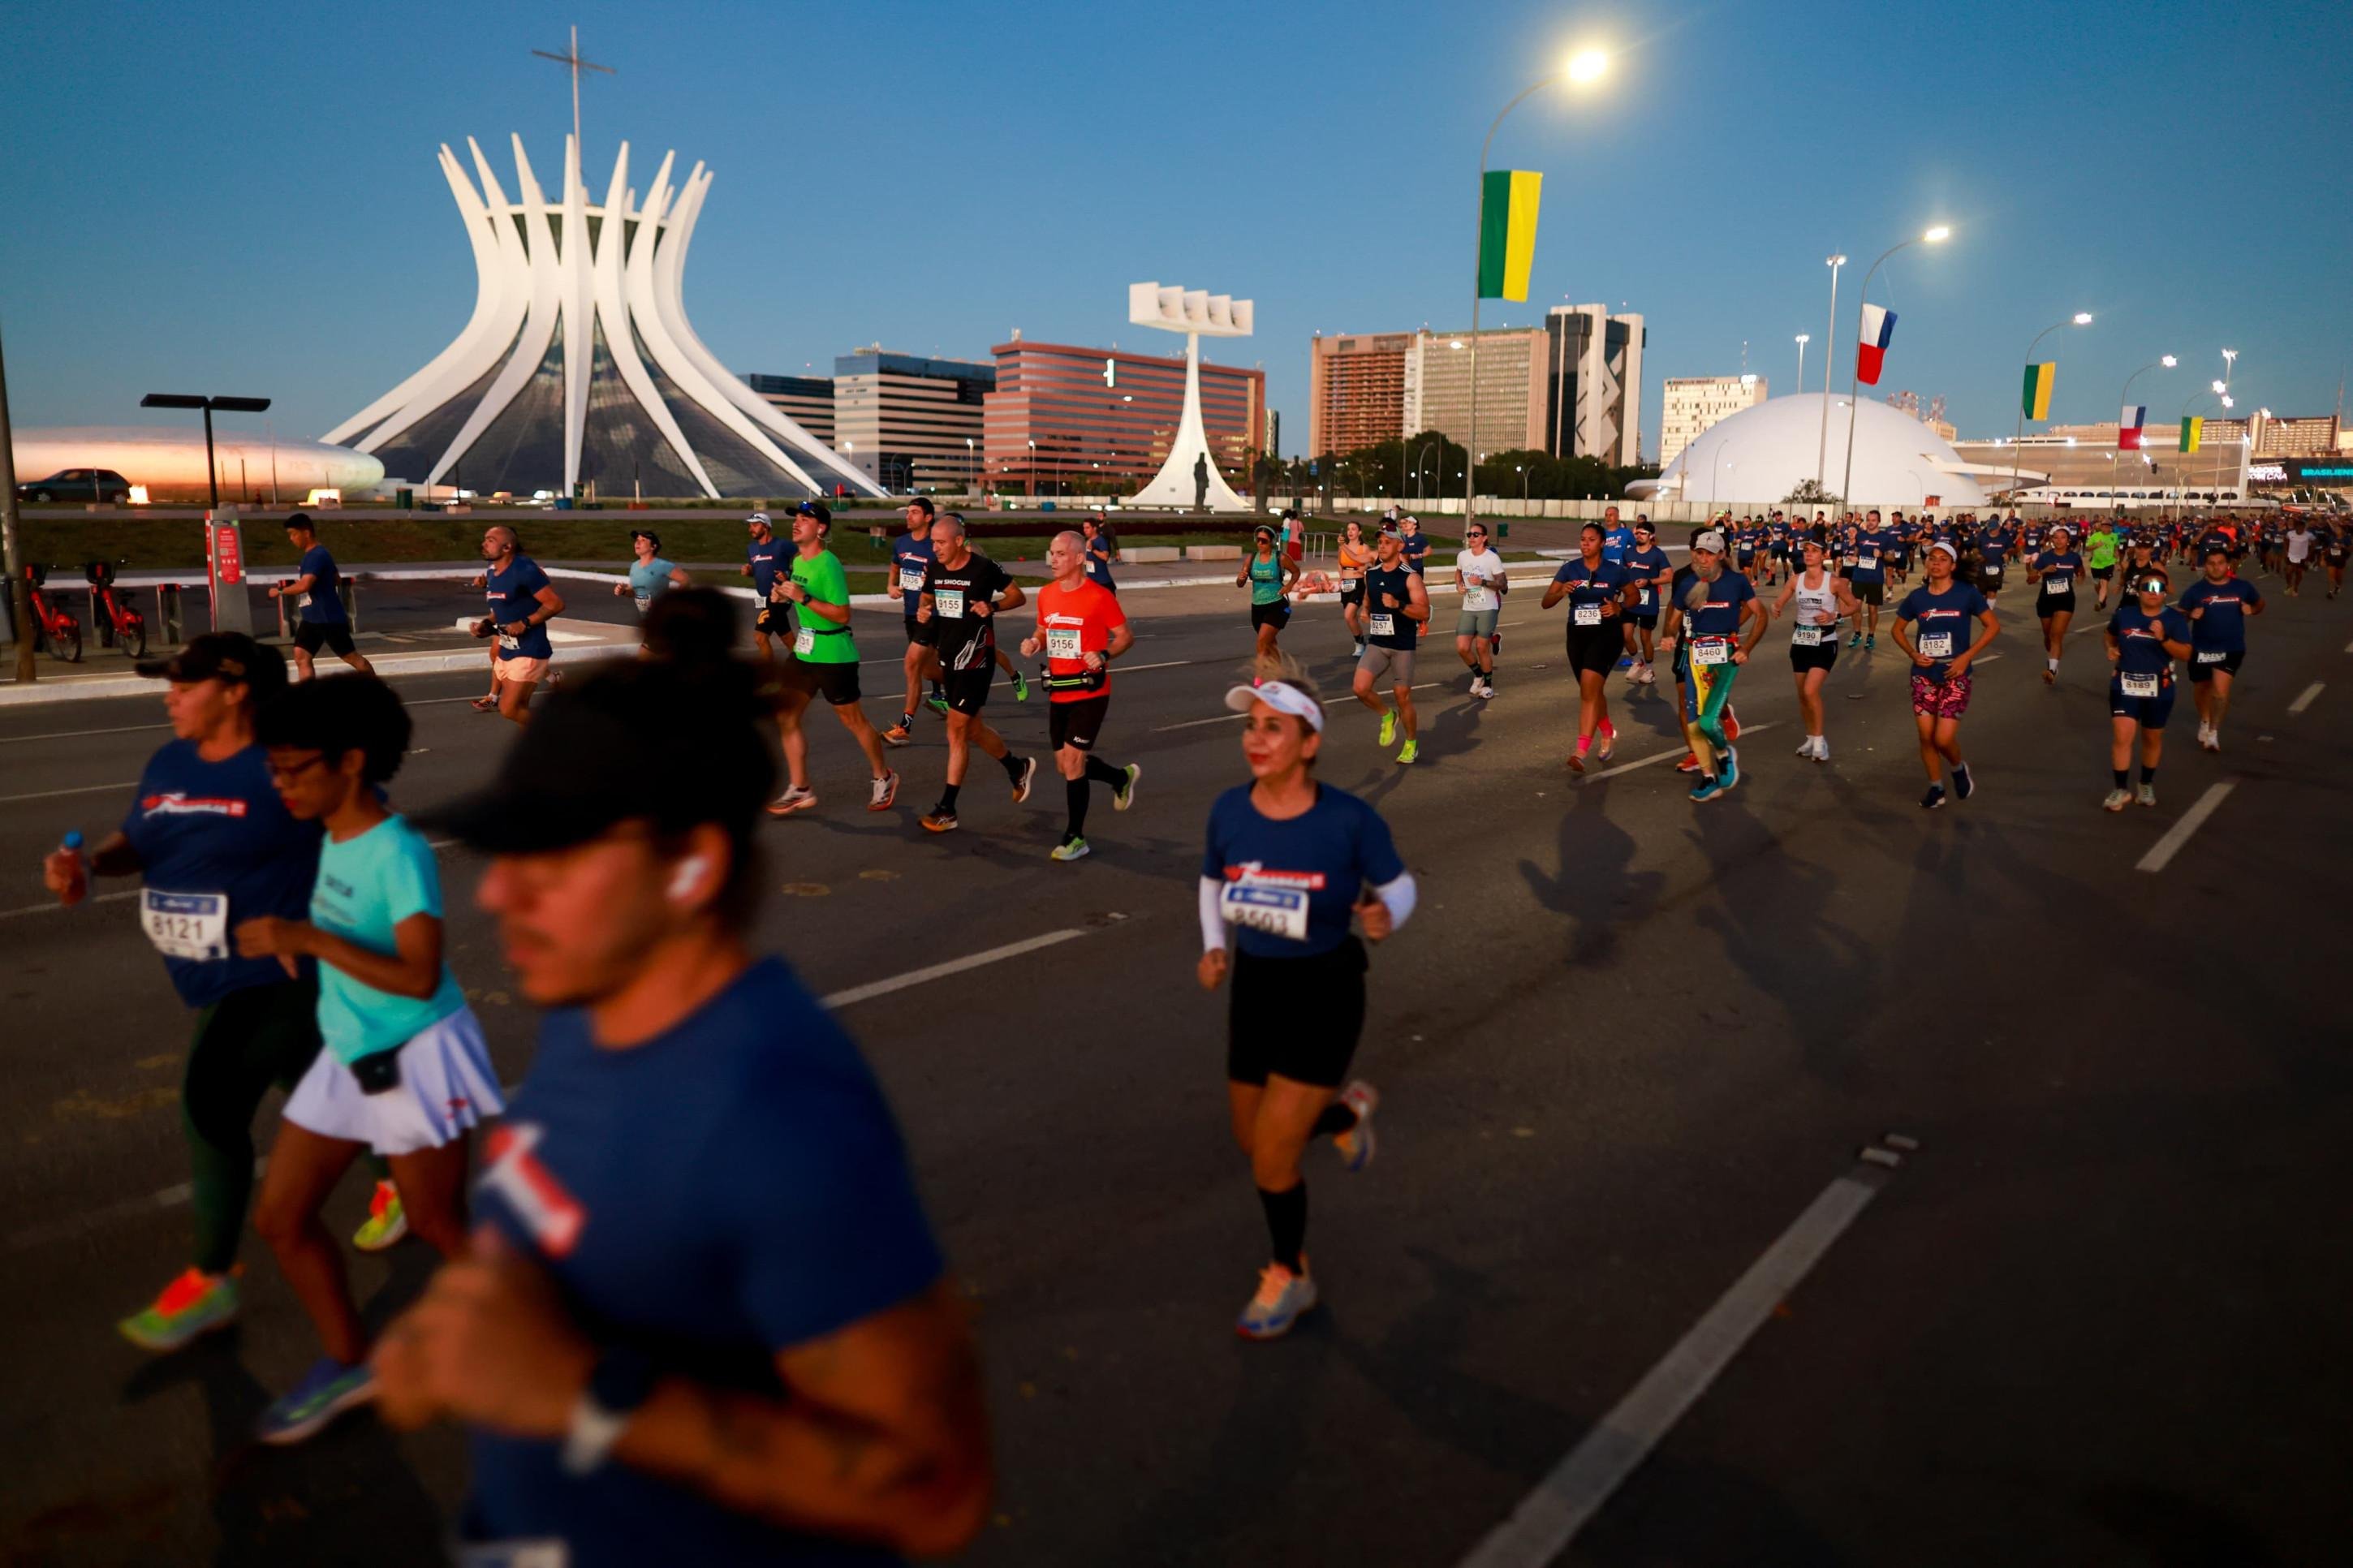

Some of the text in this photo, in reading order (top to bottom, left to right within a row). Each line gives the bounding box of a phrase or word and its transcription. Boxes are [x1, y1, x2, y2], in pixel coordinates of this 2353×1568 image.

[938, 599, 959, 610] 9155
[1051, 639, 1074, 649] 9156
[1924, 640, 1945, 648] 8182
[1698, 648, 1721, 657] 8460
[2126, 681, 2150, 689] 8189
[152, 915, 203, 940] 8121
